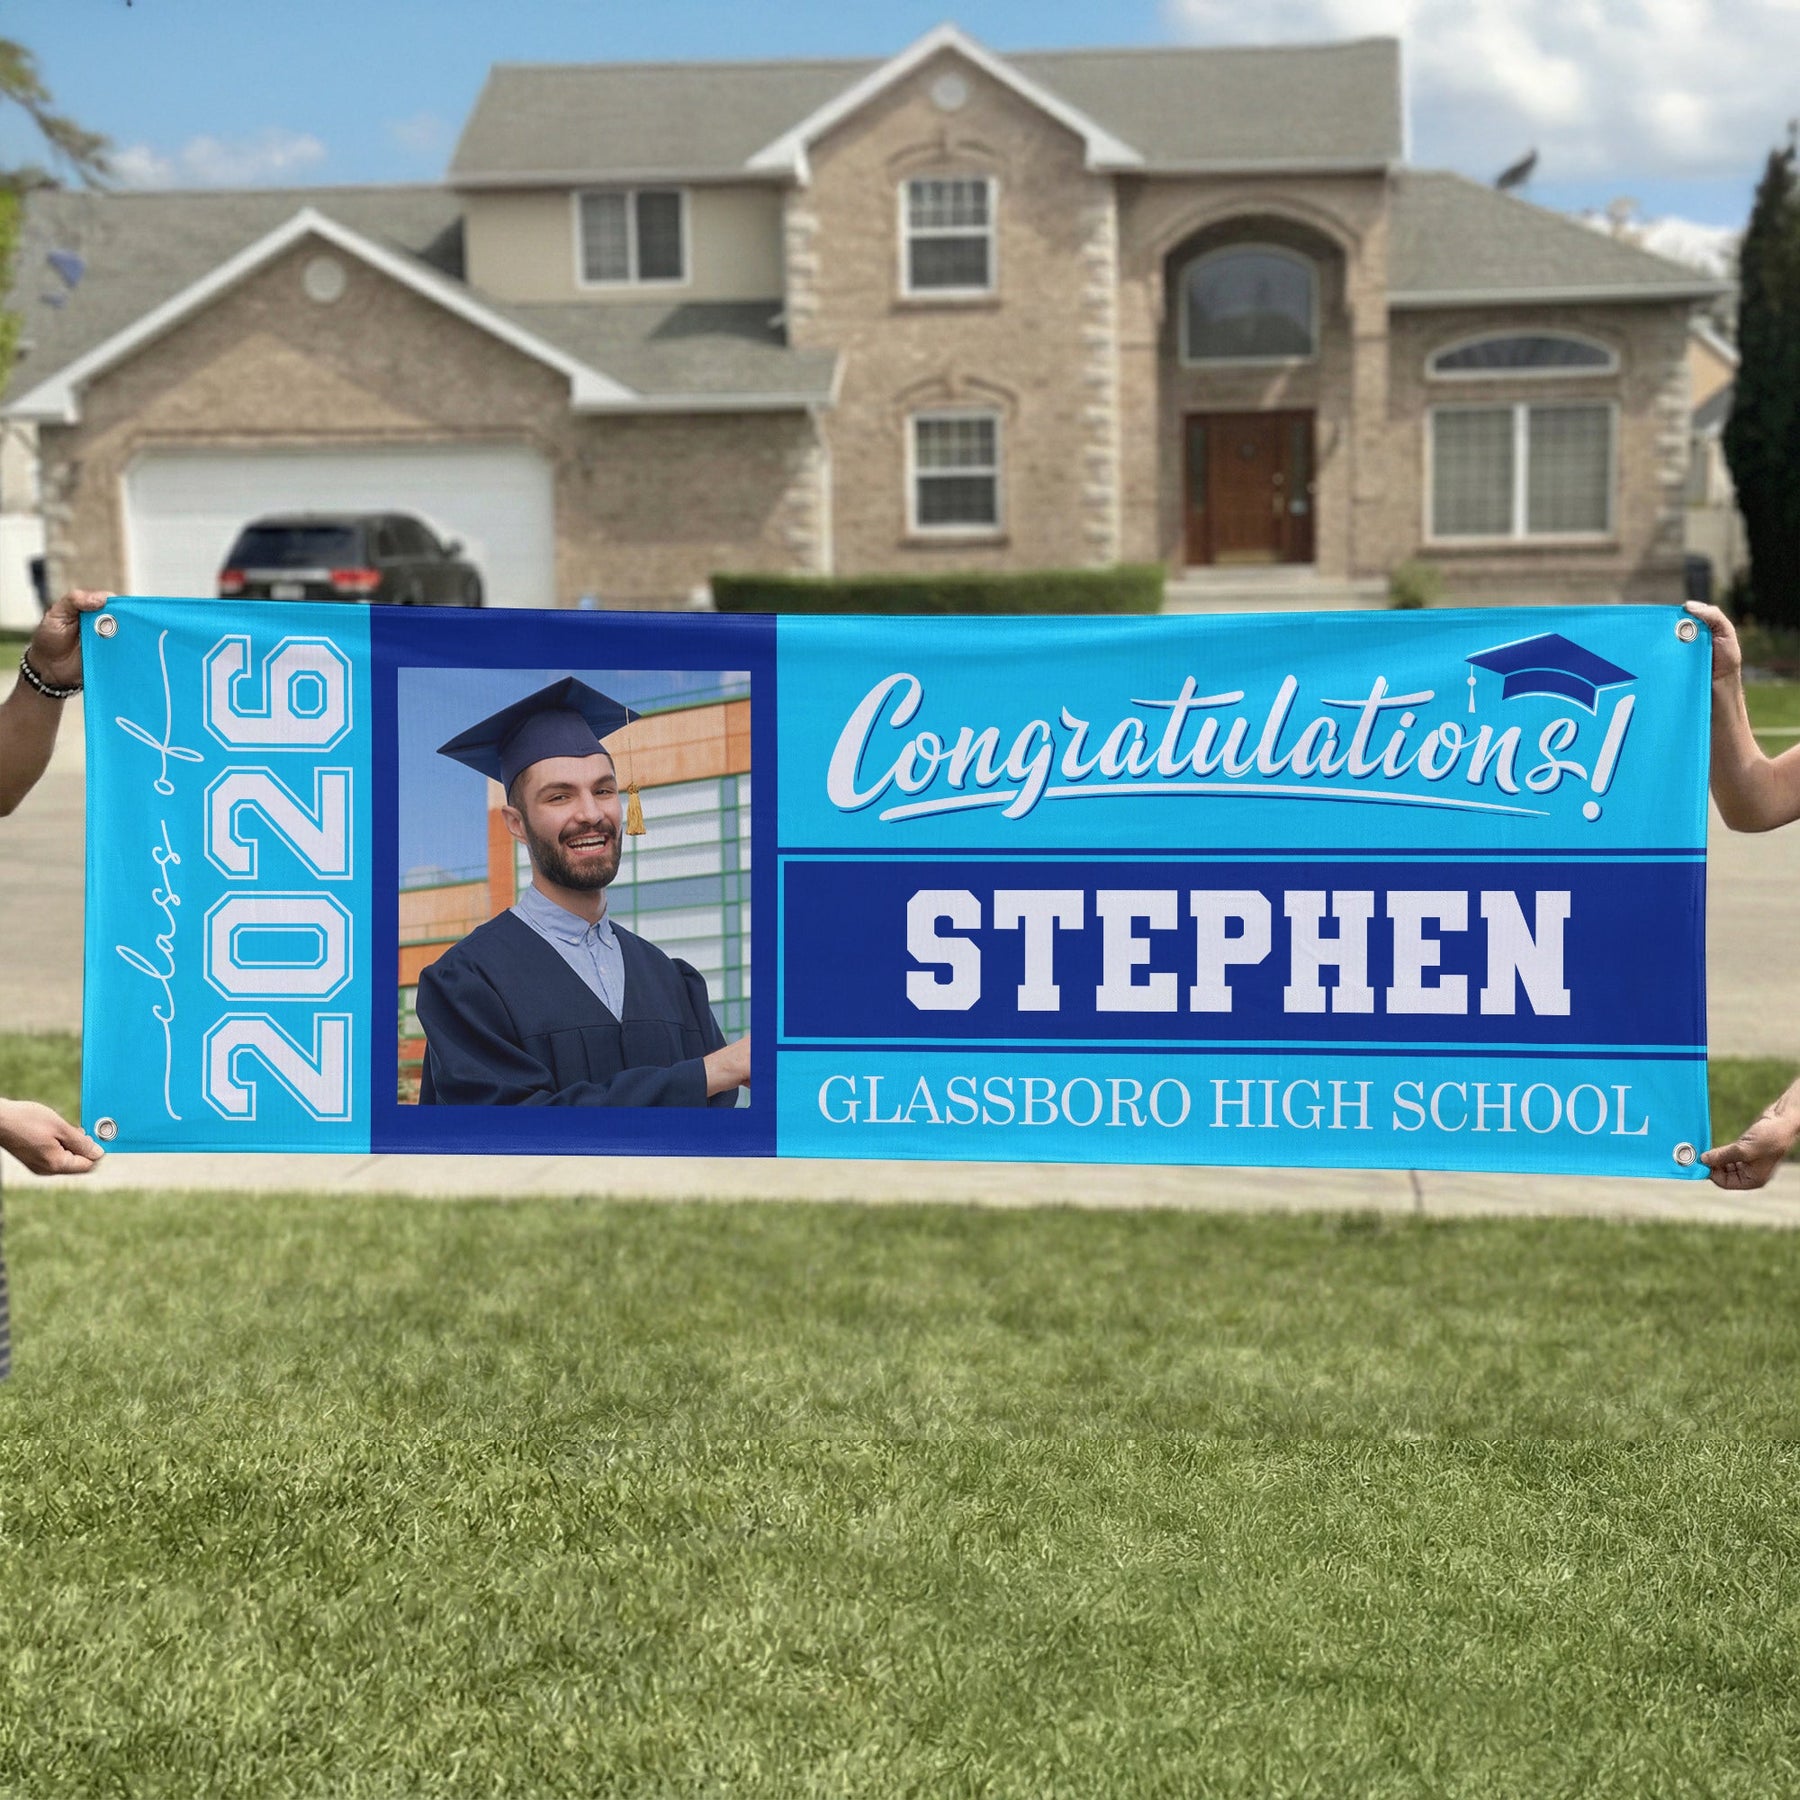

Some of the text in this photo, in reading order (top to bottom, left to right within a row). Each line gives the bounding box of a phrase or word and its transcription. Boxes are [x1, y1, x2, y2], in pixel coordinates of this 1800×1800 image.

[826, 672, 1637, 821] Congratulations!
[115, 629, 205, 1121] class of
[201, 633, 354, 1123] 2026
[906, 889, 1572, 1017] STEPHEN
[817, 1074, 1650, 1137] GLASSBORO HIGH SCHOOL
